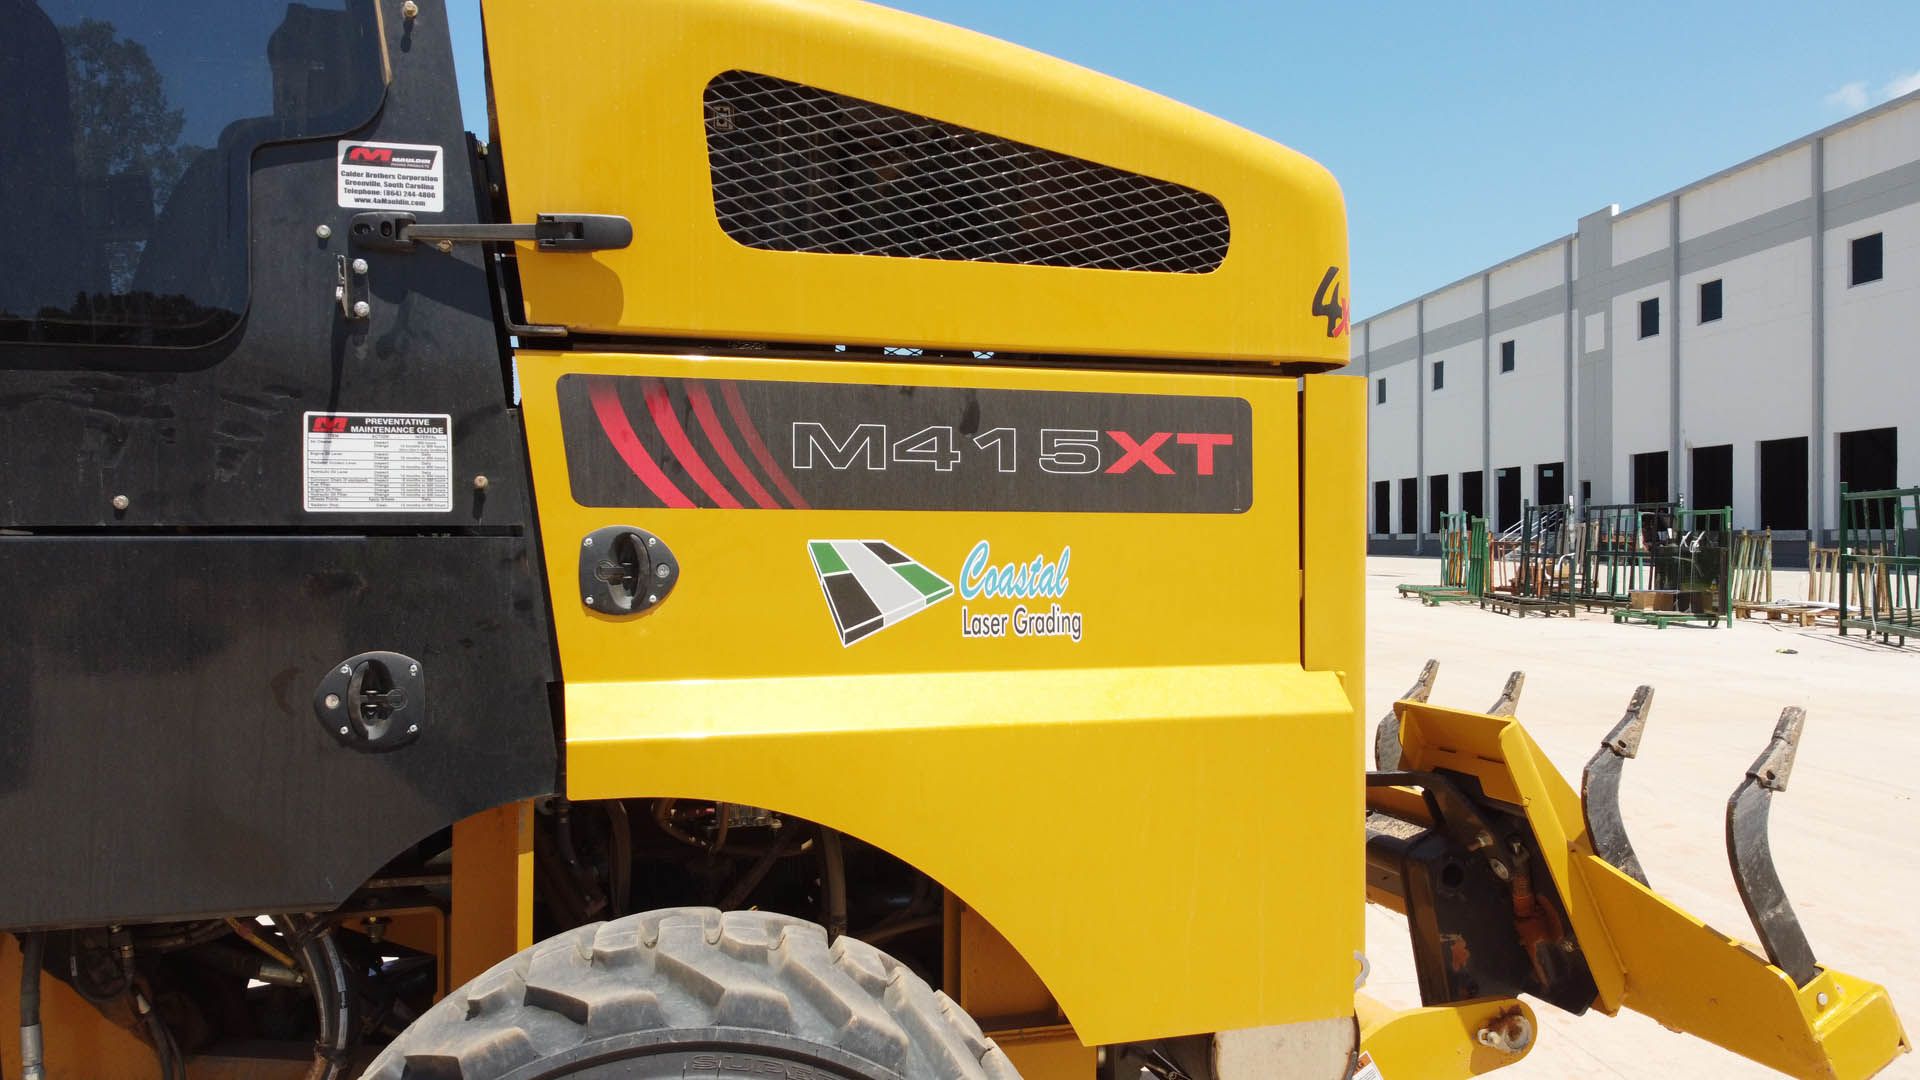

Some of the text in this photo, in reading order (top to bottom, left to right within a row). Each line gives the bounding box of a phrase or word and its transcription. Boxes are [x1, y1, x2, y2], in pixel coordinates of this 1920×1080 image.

[341, 170, 438, 182] Calder Brothers Corporation
[384, 181, 404, 189] South
[405, 182, 434, 190] Carolina
[344, 187, 381, 196] Telephone:
[383, 189, 402, 197] (864)
[354, 197, 426, 206] www.4aMauldin.com
[365, 417, 430, 426] PREVENTATIVE
[350, 426, 415, 434] MAINTENANCE
[960, 540, 1070, 600] Coastal
[963, 605, 1082, 641] Laser Grading
